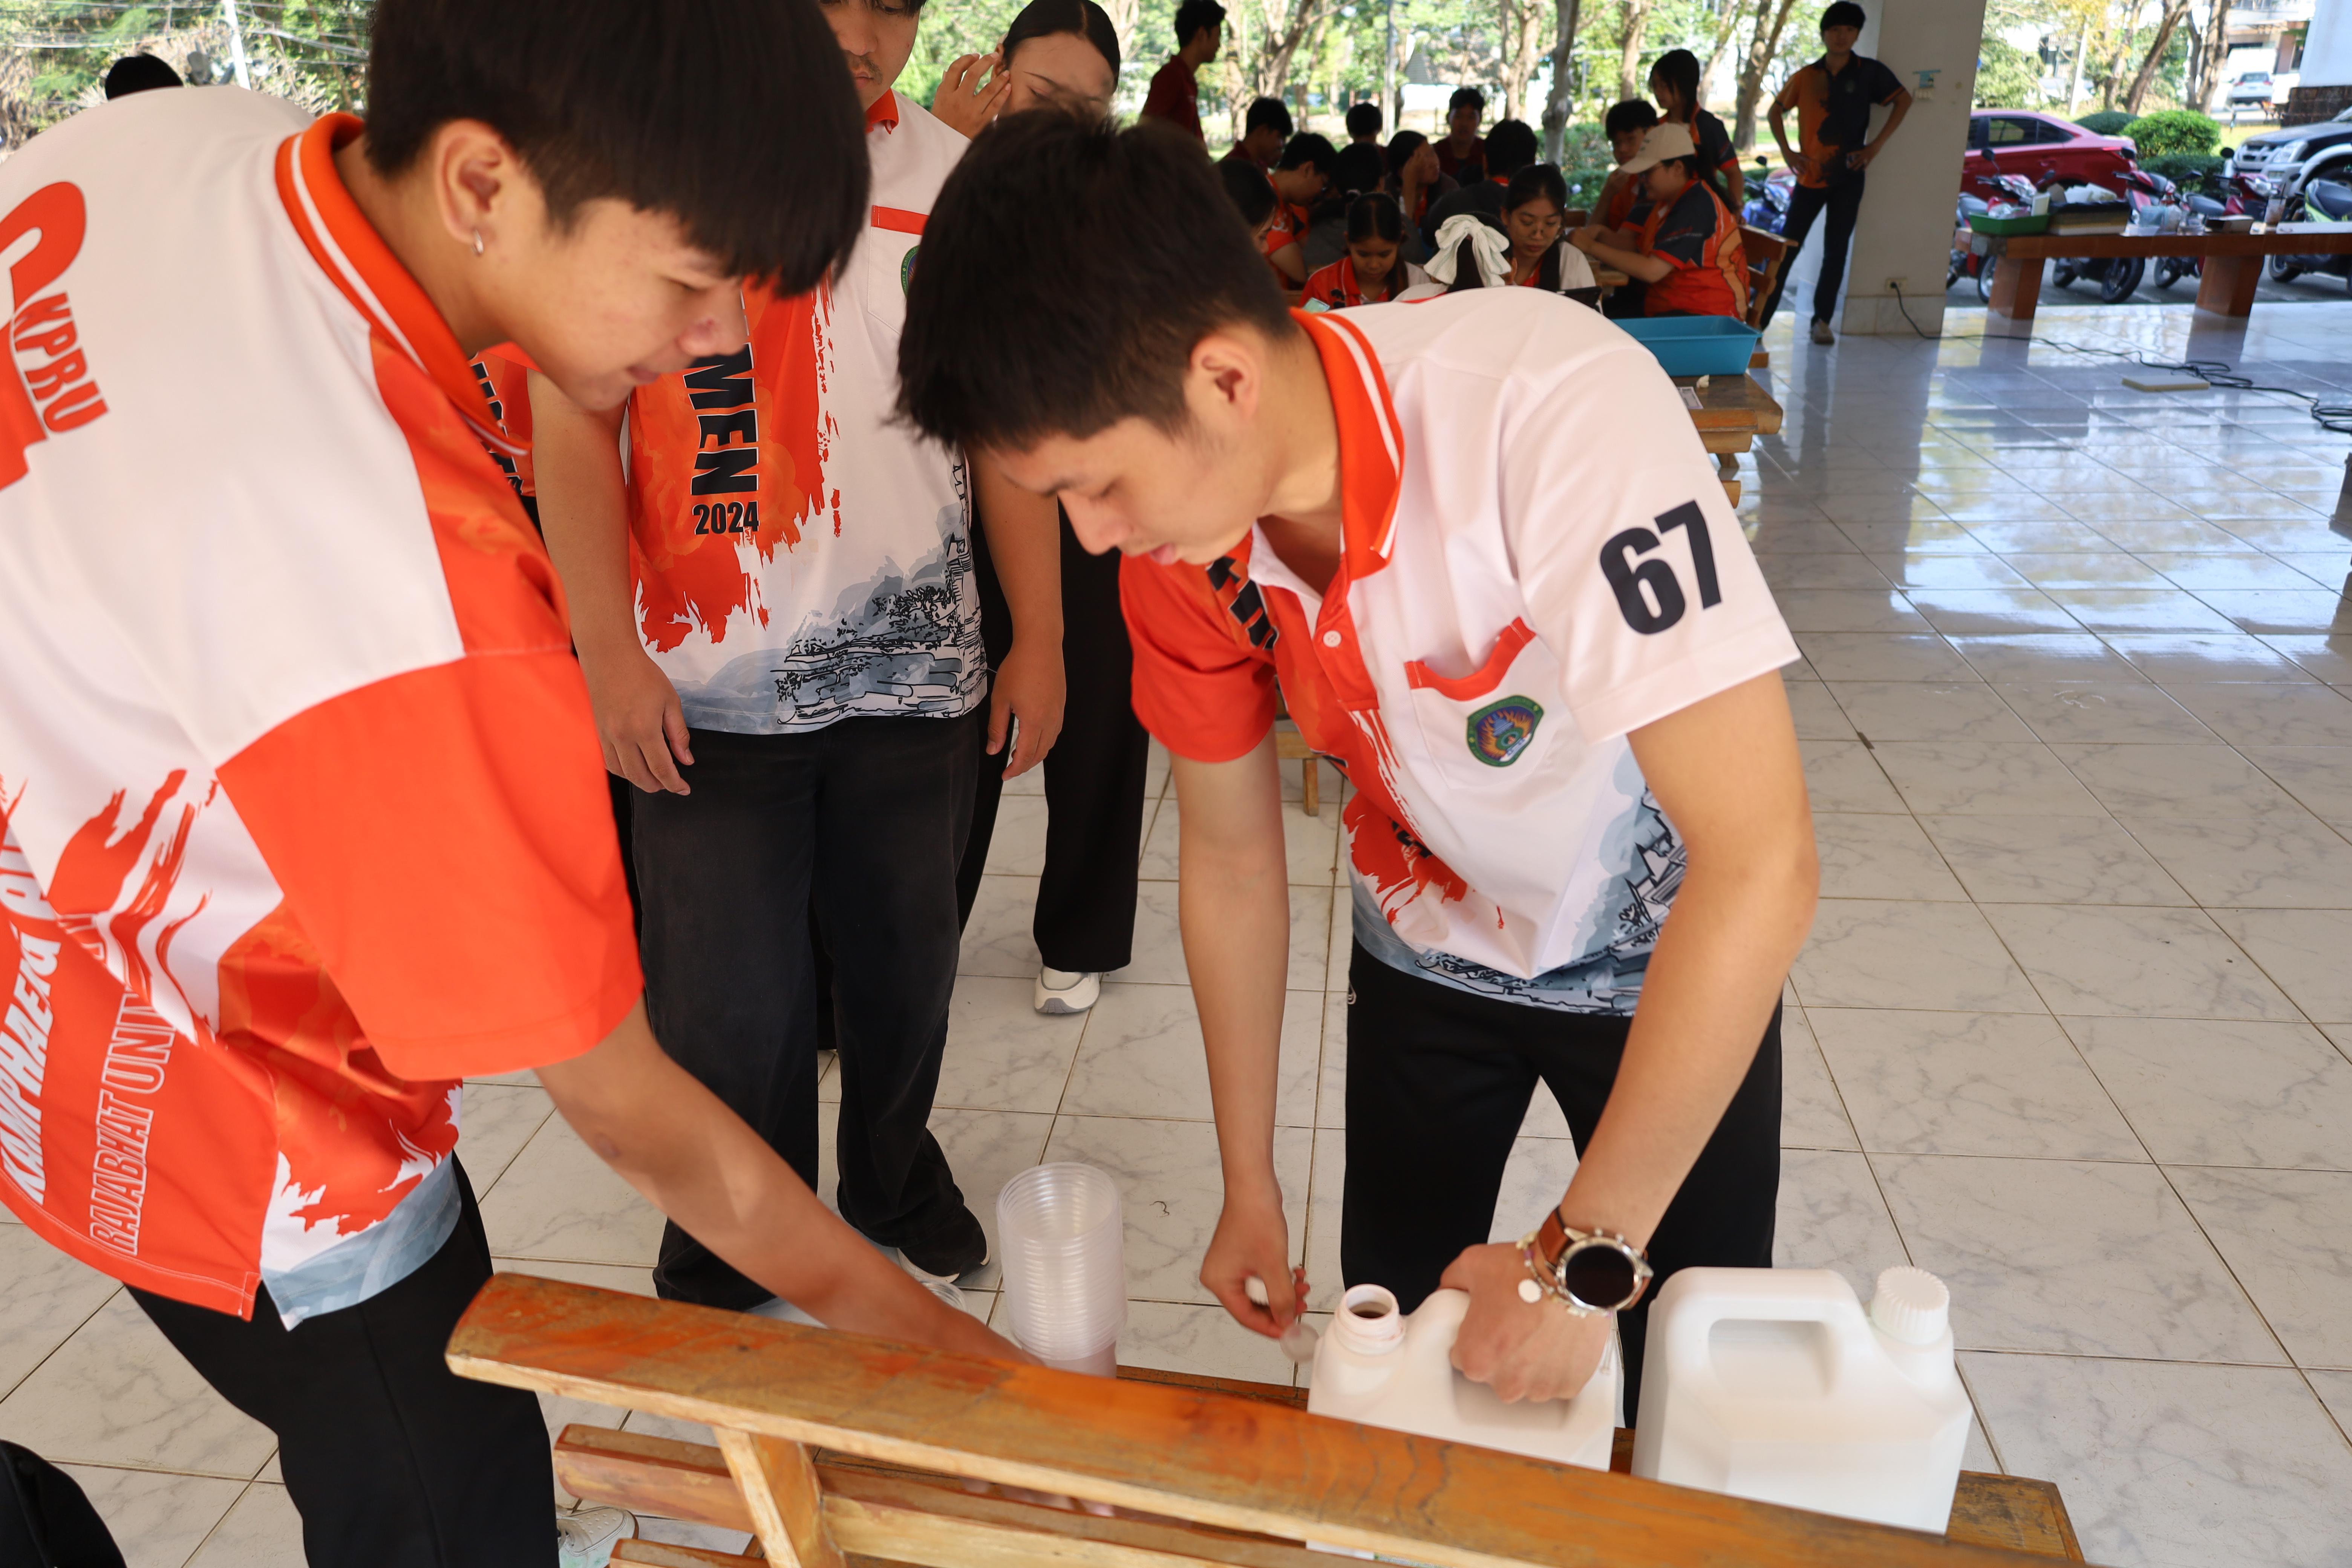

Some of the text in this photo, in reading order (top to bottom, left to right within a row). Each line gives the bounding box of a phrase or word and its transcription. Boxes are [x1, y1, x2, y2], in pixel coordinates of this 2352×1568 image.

[14, 291, 109, 434] KPRU
[692, 501, 759, 535] 2024
[1599, 499, 1722, 635] 67
[89, 1088, 154, 1256] RAJABHAT
